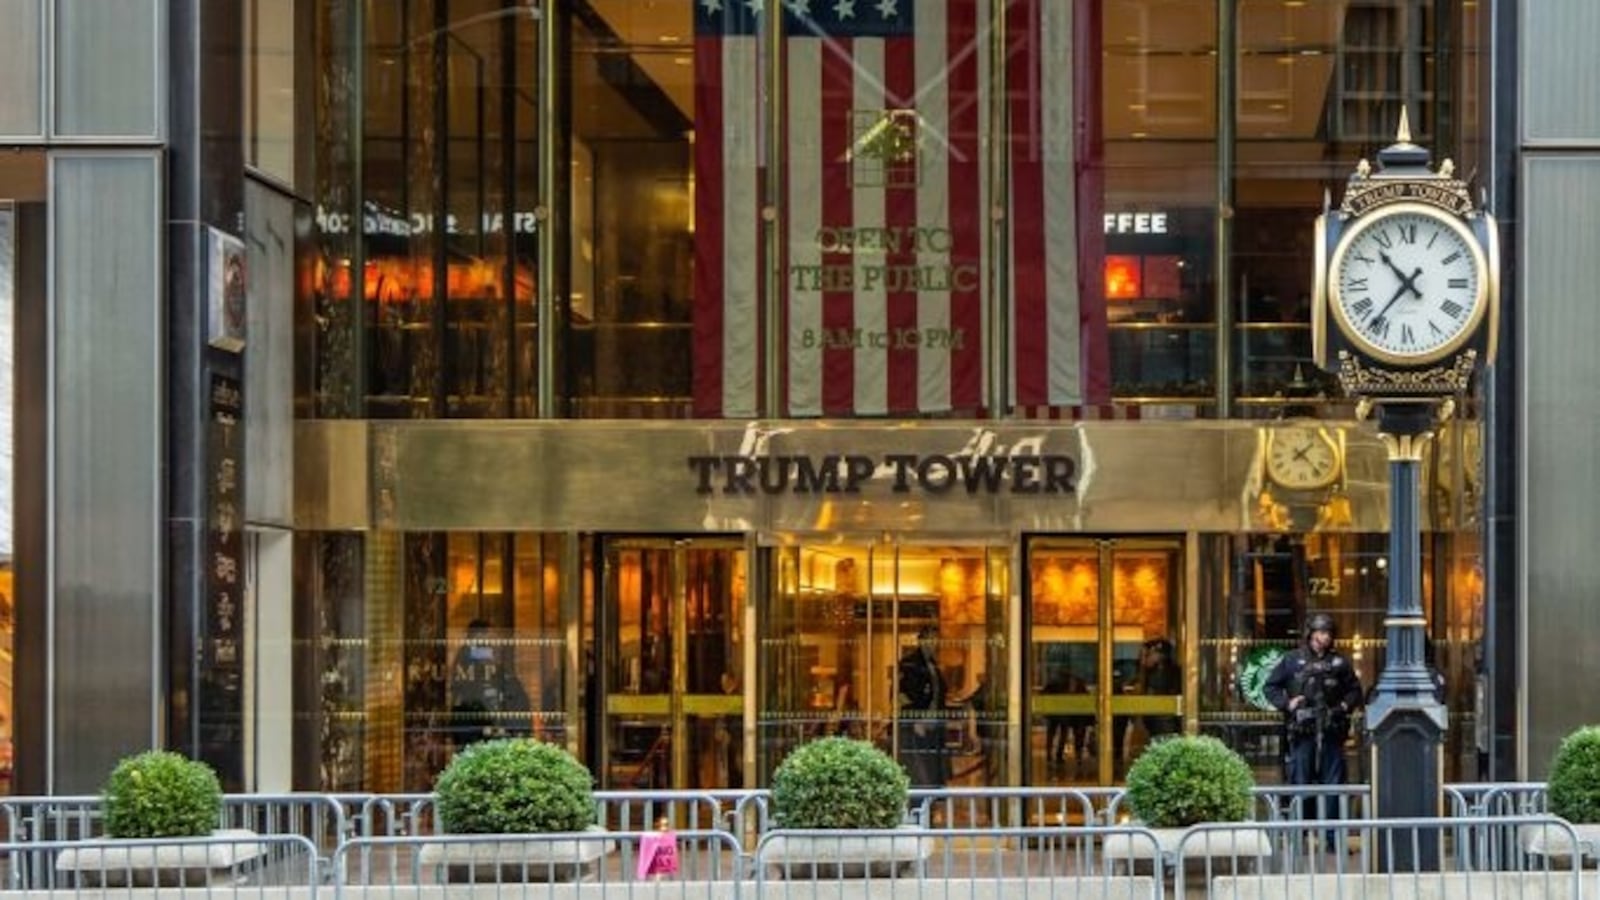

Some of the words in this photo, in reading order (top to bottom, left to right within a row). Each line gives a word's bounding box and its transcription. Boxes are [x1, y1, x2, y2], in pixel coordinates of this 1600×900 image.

[1358, 184, 1404, 209] TRUMP
[1408, 184, 1458, 212] TOWER
[1103, 212, 1167, 234] FFEE
[816, 227, 899, 253] OPEN
[911, 227, 952, 253] TO
[790, 265, 854, 291] THE
[862, 265, 978, 292] PUBLIC
[802, 328, 815, 348] 8
[818, 328, 864, 349] AM
[868, 329, 888, 348] to
[893, 329, 922, 349] 10
[925, 328, 966, 349] PM
[687, 455, 875, 494] TRUMP
[885, 455, 1076, 494] TOWER
[1308, 578, 1341, 596] 725
[387, 663, 497, 681] RUMP
